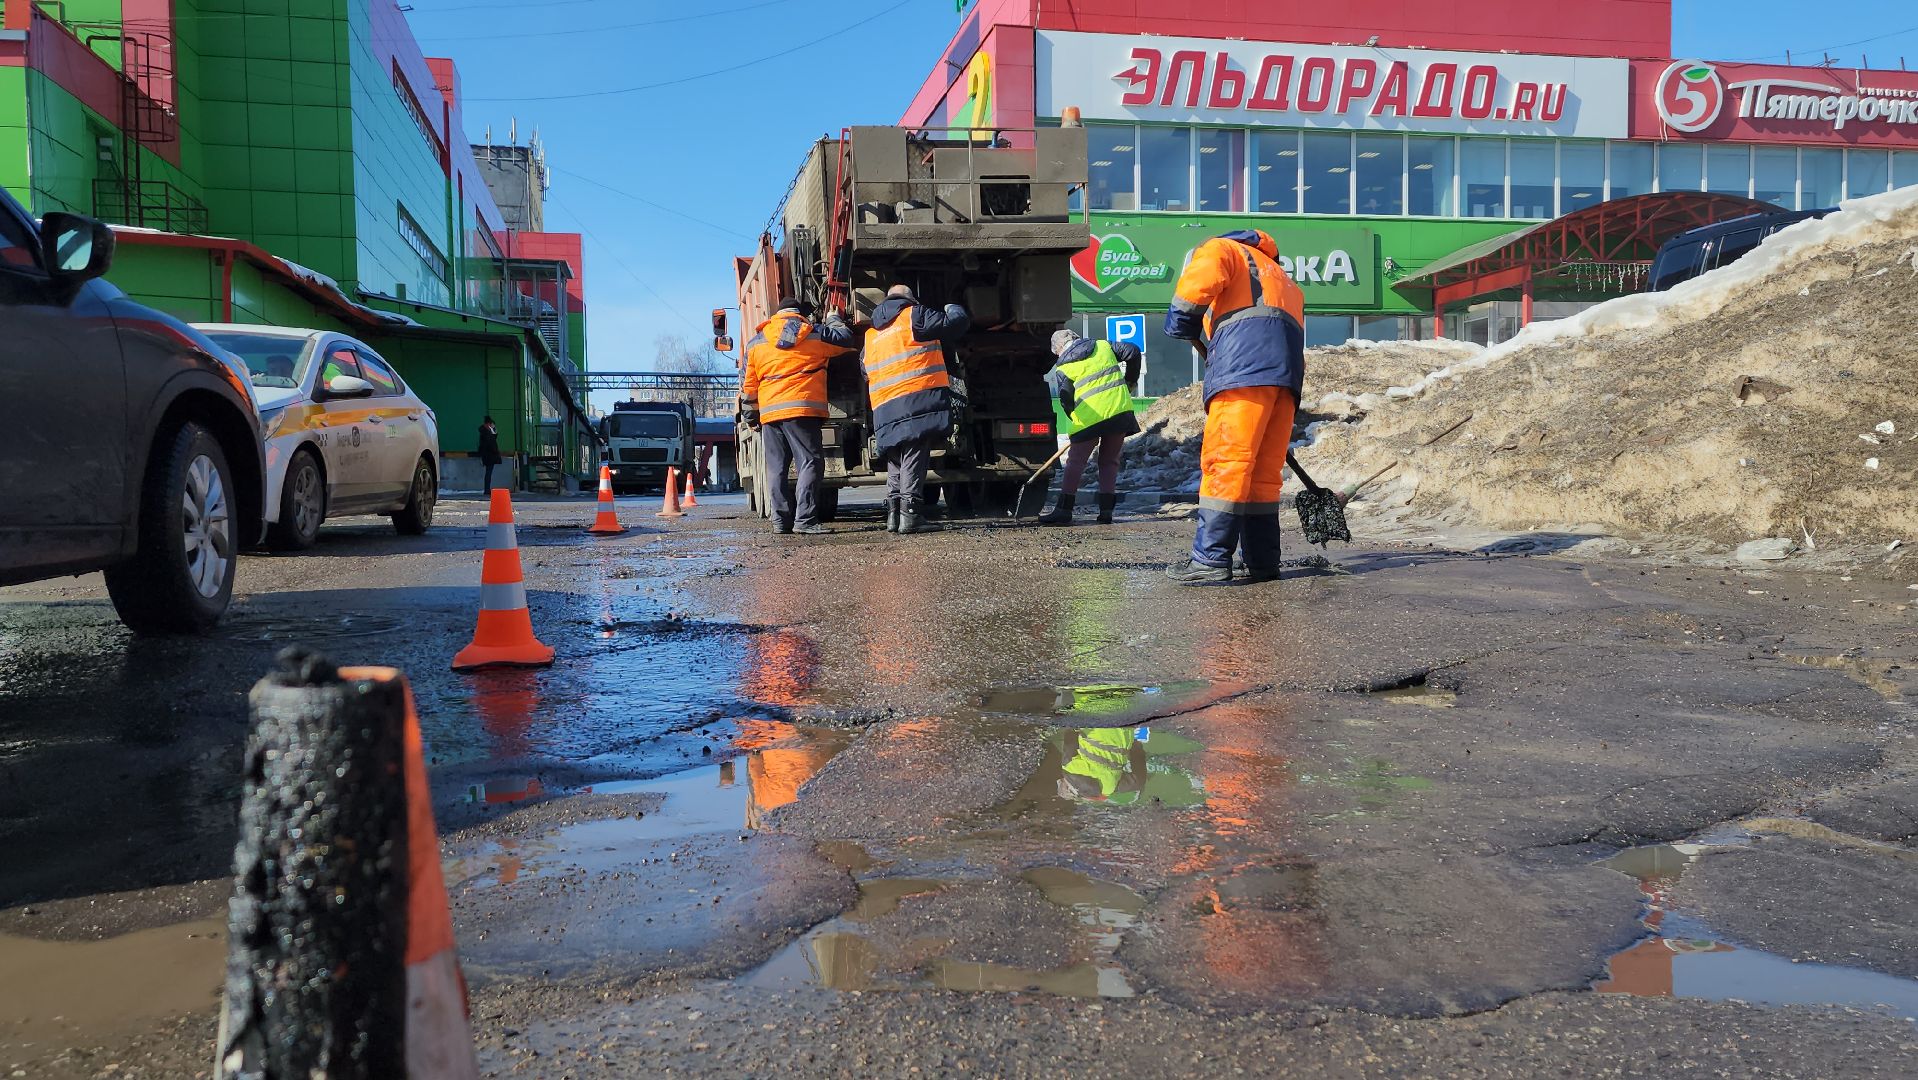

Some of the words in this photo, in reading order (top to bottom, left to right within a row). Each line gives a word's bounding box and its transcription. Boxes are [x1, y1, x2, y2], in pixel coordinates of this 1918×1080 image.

[1110, 46, 1567, 122] ЭЛЬДОРАДО.RU
[1859, 87, 1918, 98] УНИВЕРС
[1101, 249, 1140, 264] Будь
[1102, 262, 1166, 278] здоров!
